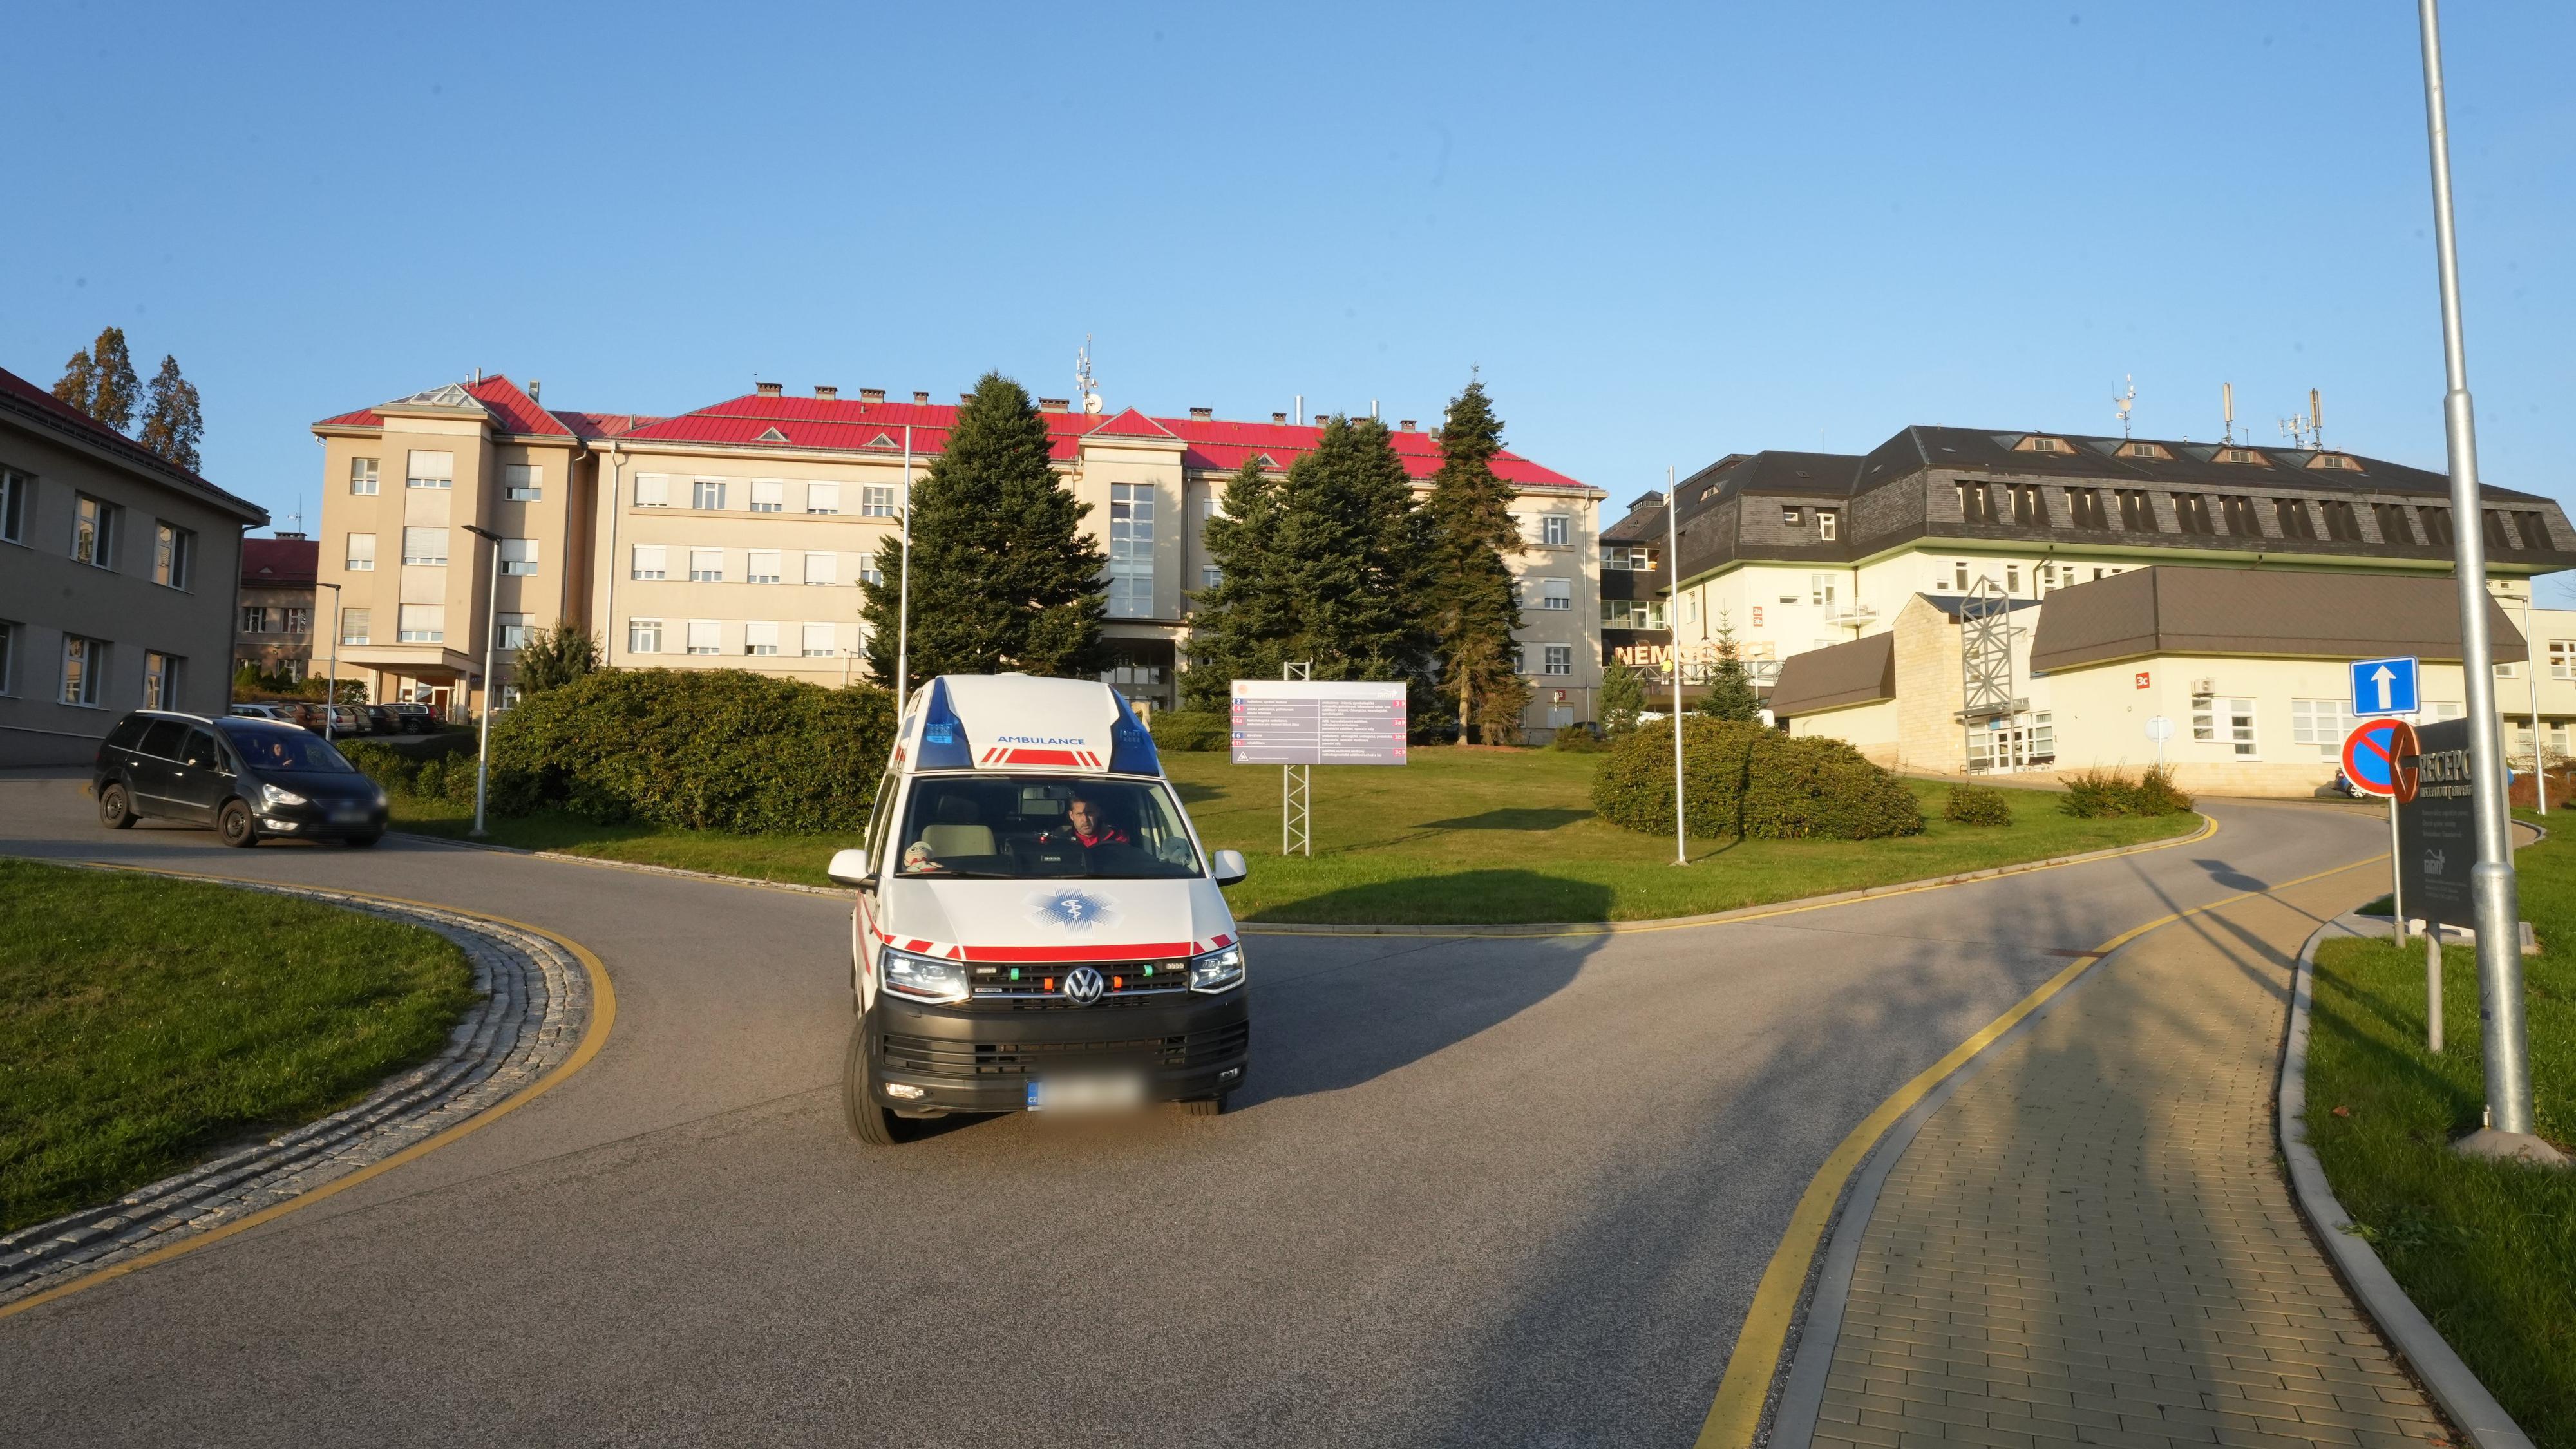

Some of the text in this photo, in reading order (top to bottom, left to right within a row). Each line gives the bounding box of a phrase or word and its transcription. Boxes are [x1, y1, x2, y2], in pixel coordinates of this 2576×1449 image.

[2137, 676, 2148, 686] 3c
[998, 736, 1085, 745] AMBULANCE
[2420, 748, 2472, 782] RECEPC
